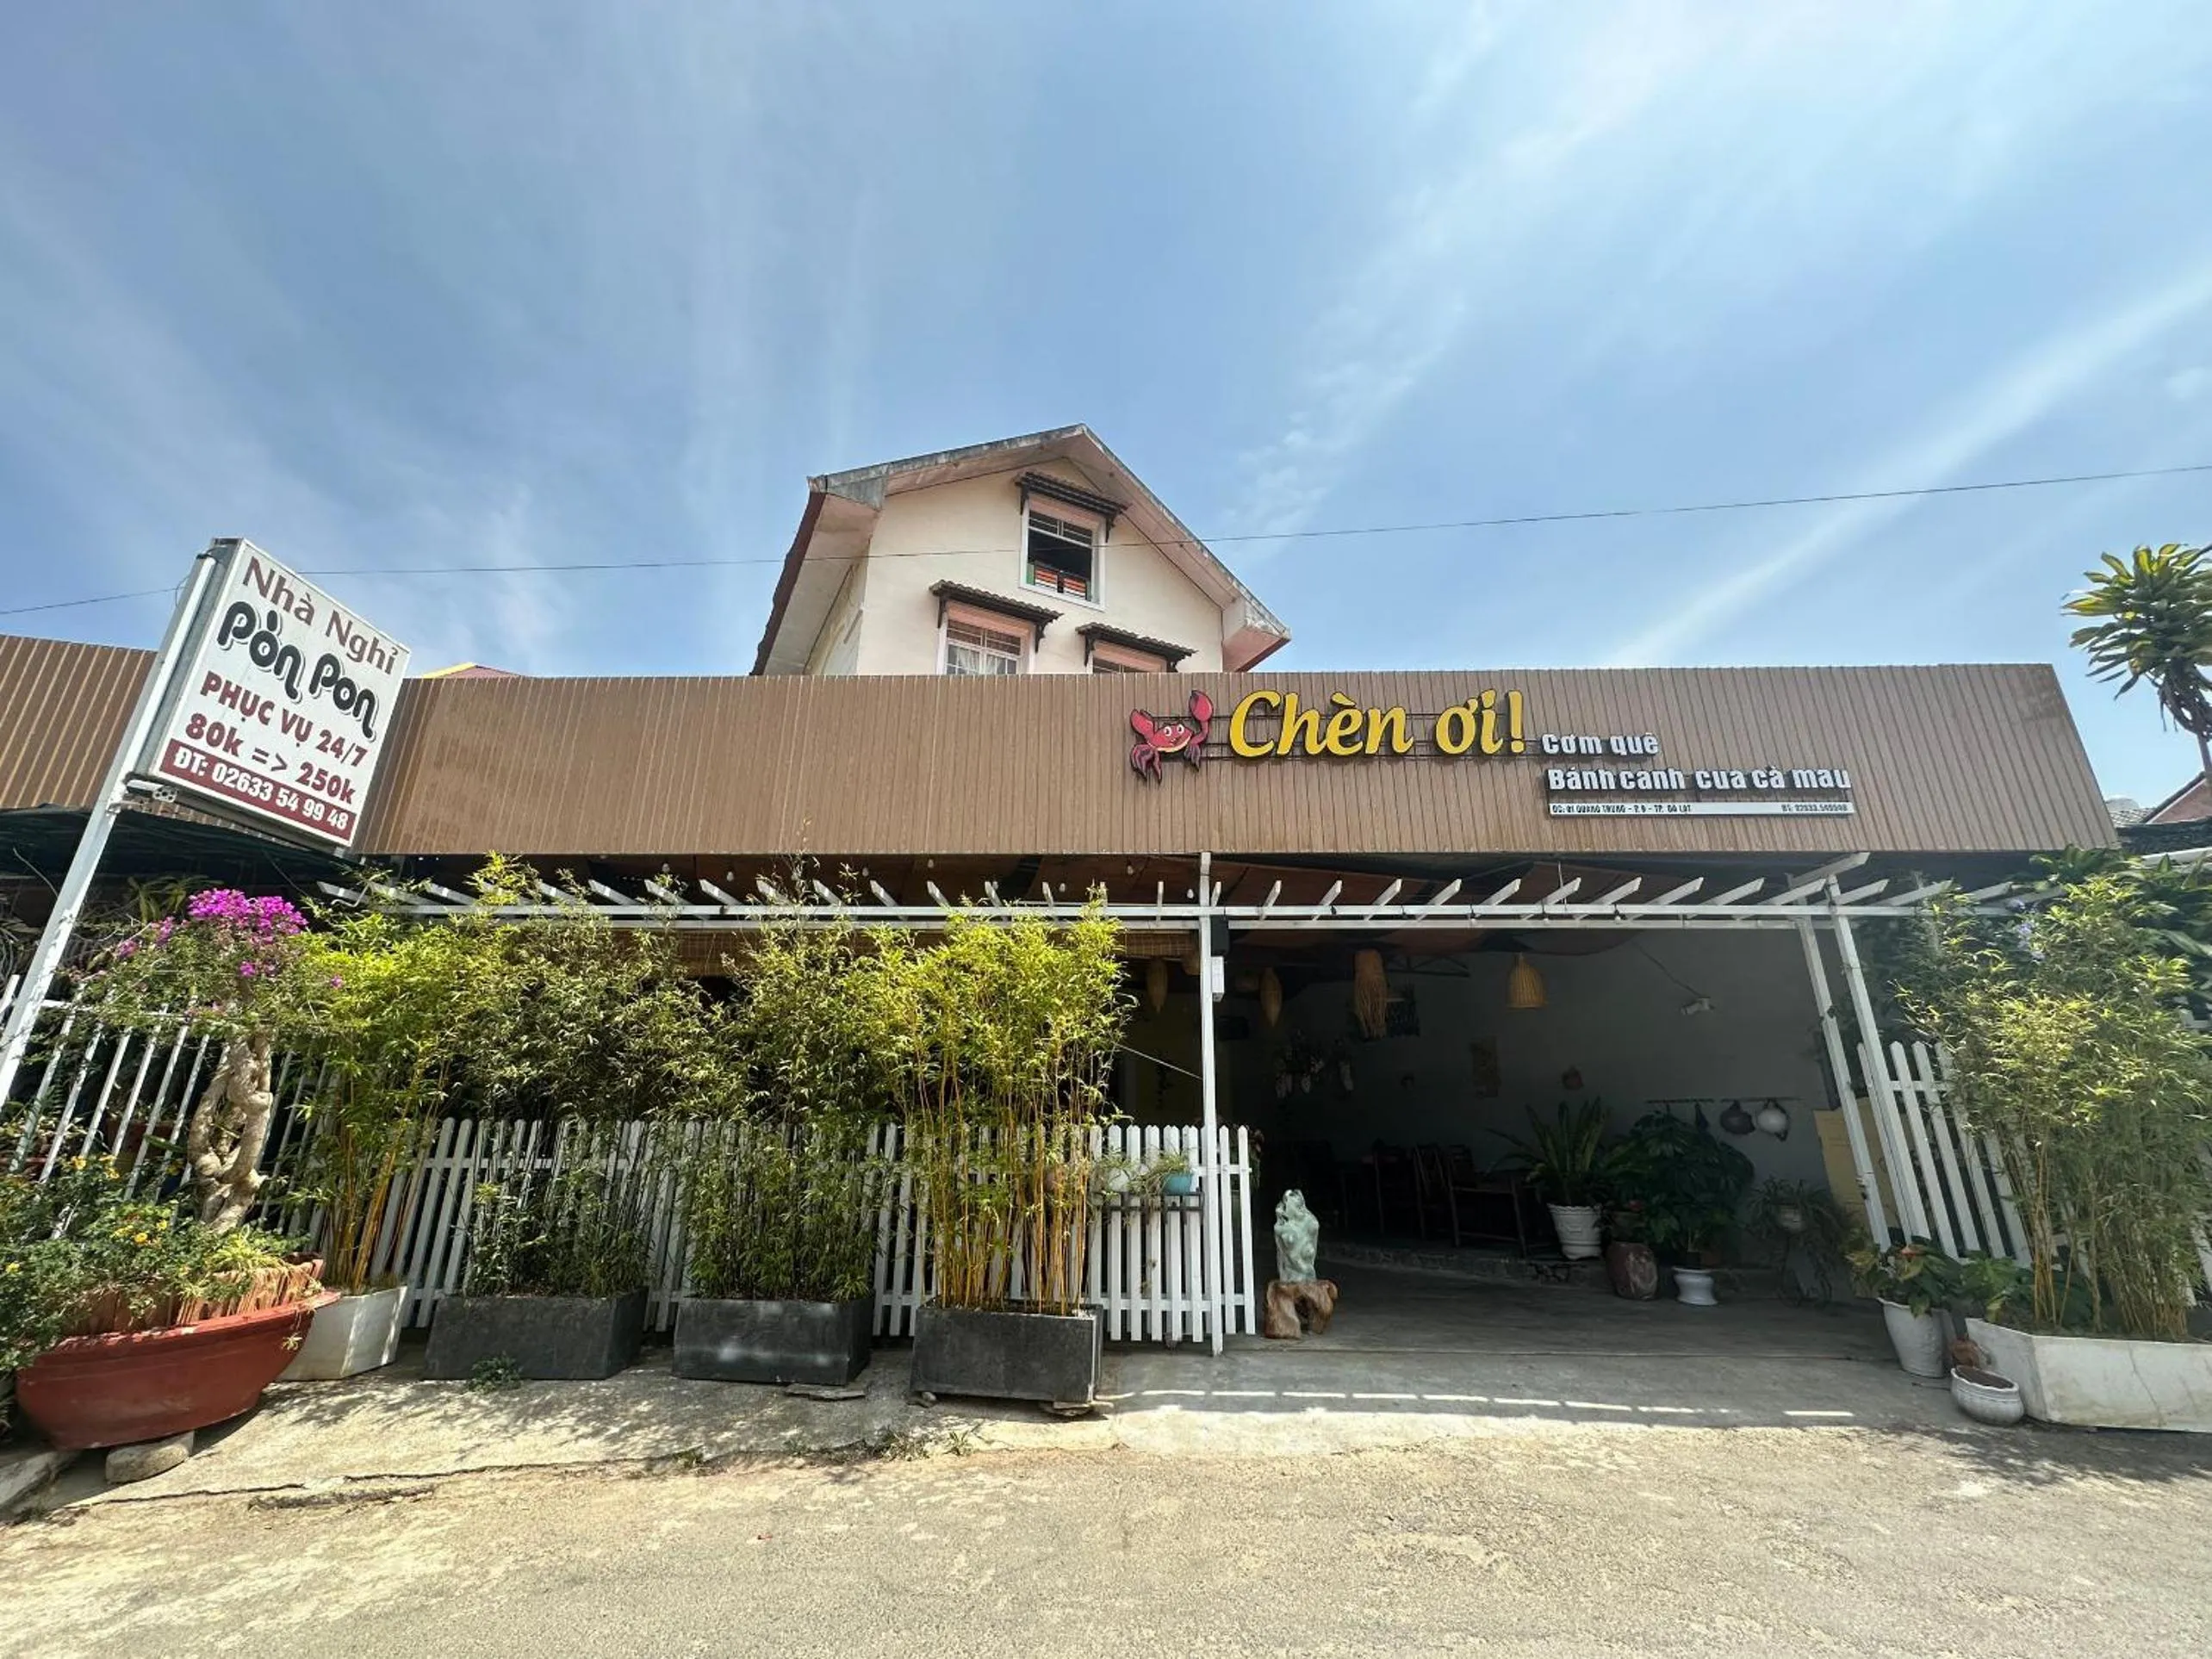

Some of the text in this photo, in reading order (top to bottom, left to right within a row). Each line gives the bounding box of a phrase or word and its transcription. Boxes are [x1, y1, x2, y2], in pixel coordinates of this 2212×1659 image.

[243, 556, 399, 675] Nhà Nghỉ
[200, 670, 368, 767] PHỤC VỤ 24/7
[308, 653, 377, 740] Pon
[1229, 688, 1525, 757] Chèn ơi!
[185, 712, 244, 757] 80k
[295, 761, 356, 805] 250k
[1541, 731, 1660, 756] Cơm quê
[1548, 765, 1852, 791] Bánh canh cua cà mau
[174, 749, 349, 830] ĐT: 02633 54 99 48
